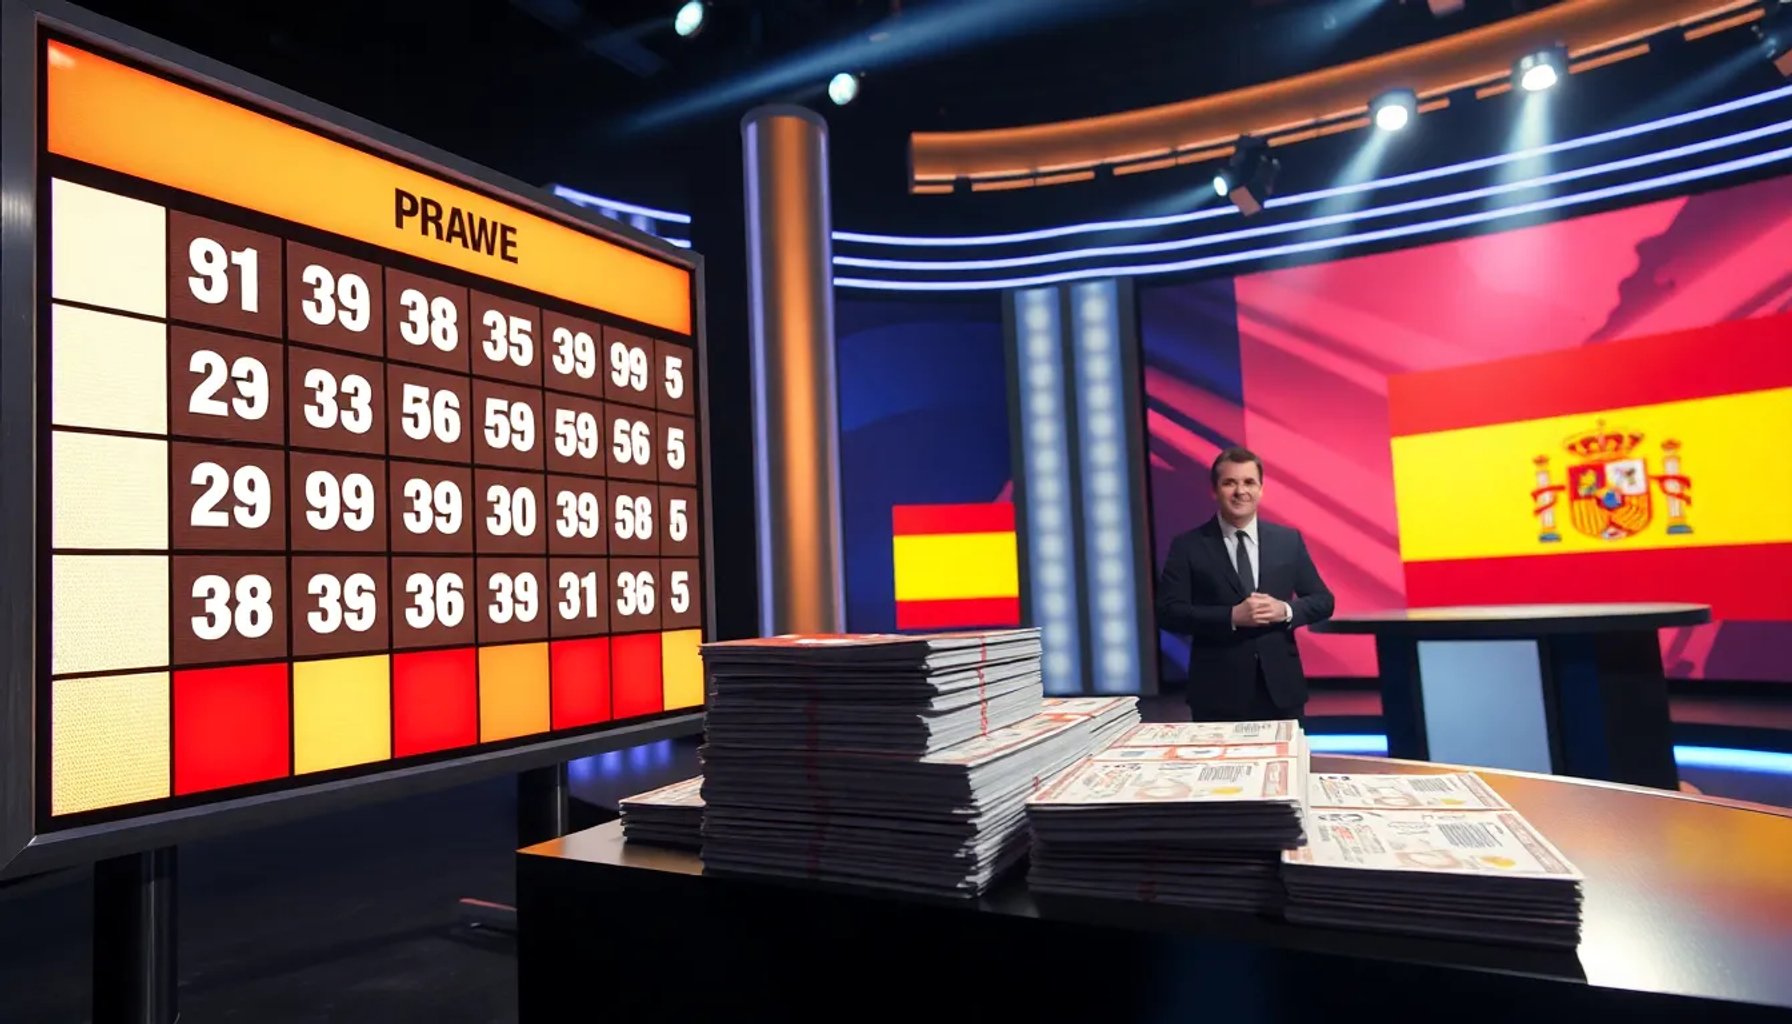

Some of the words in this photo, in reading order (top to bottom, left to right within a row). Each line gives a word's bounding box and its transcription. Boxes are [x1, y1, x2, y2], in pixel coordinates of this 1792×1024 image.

[394, 188, 519, 264] PRAWE
[301, 264, 371, 332] 39
[399, 288, 459, 352] 38
[482, 309, 534, 367] 35
[552, 326, 596, 379] 39
[610, 341, 648, 392] 99
[664, 355, 684, 399] 5
[303, 368, 373, 434] 33
[401, 383, 461, 444] 56
[483, 397, 535, 452] 59
[554, 408, 599, 459] 59
[612, 418, 651, 466] 56
[666, 427, 686, 470] 5
[190, 461, 271, 529] 29
[305, 470, 375, 532] 99
[402, 478, 463, 535] 39
[486, 484, 537, 537] 30
[555, 490, 599, 539] 39
[669, 499, 688, 542] 5
[191, 574, 274, 640] 38
[405, 572, 465, 629] 36
[488, 571, 539, 624] 39
[558, 571, 598, 620] 31
[616, 570, 655, 616] 36
[670, 570, 690, 614] 5
